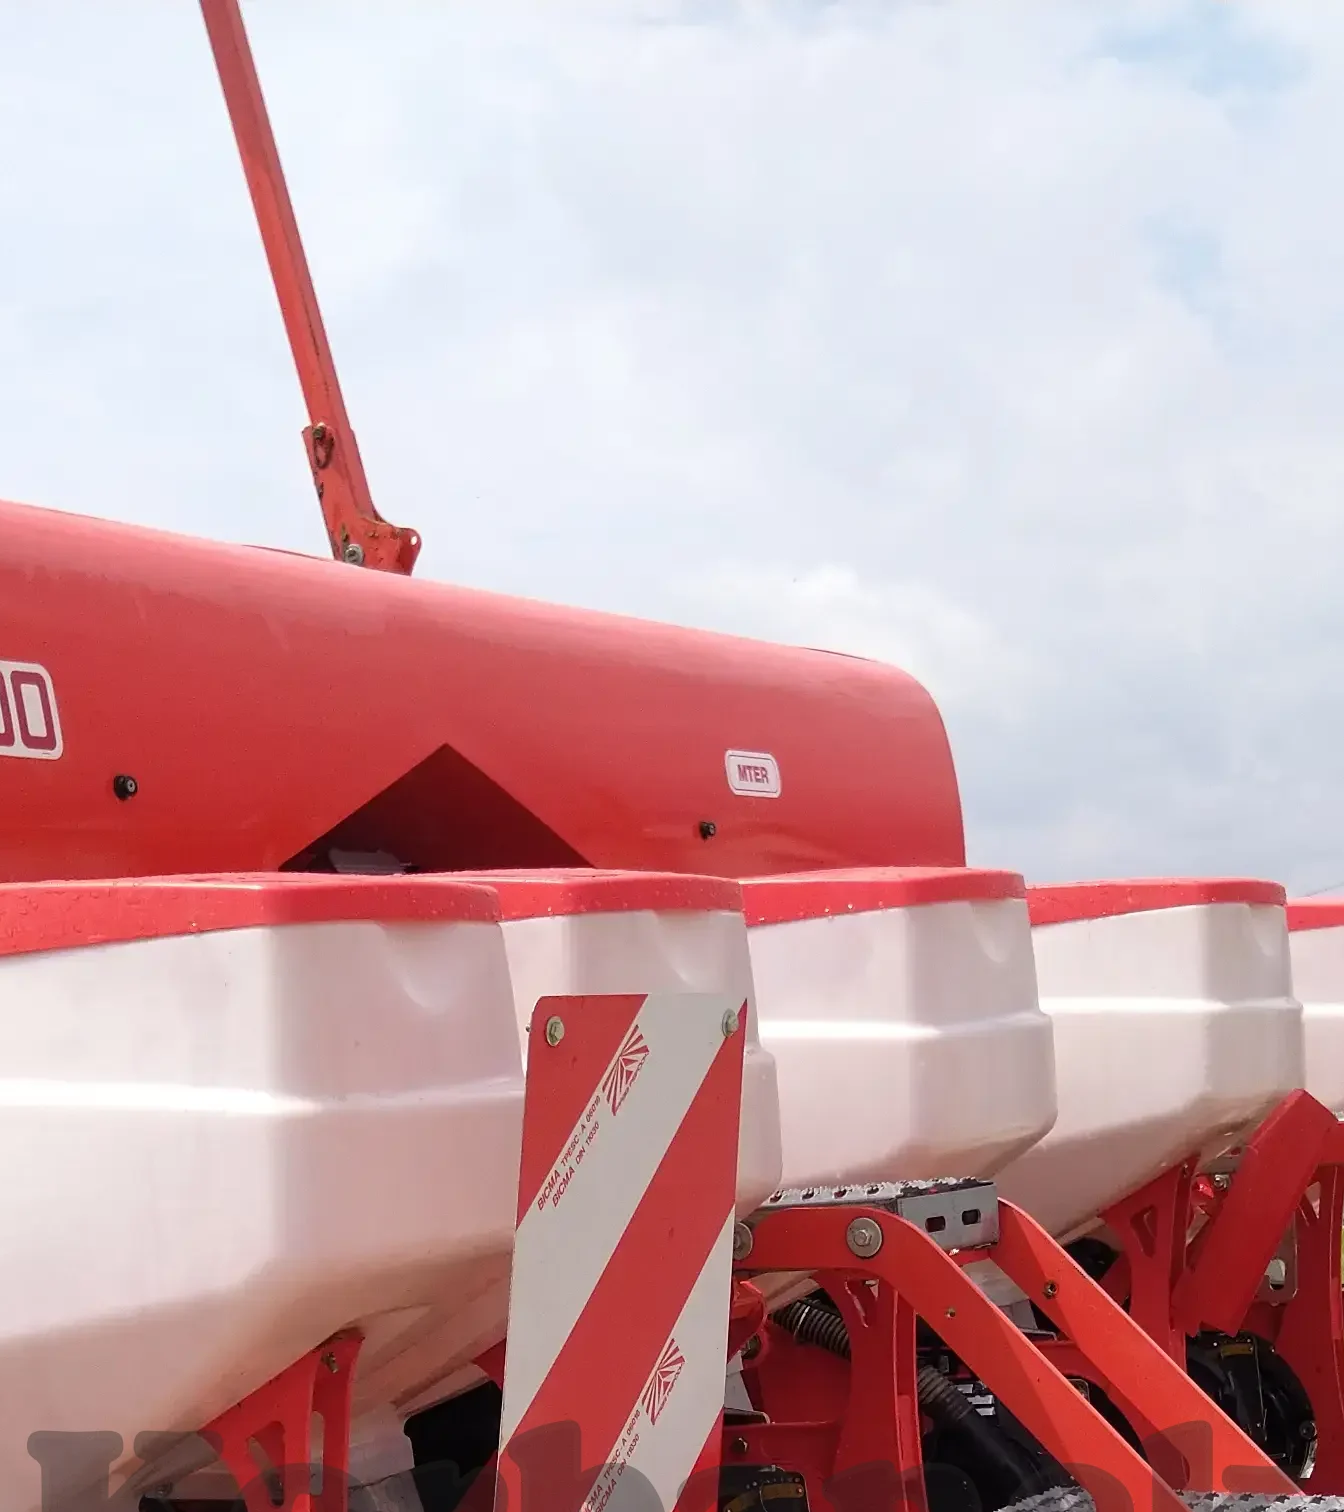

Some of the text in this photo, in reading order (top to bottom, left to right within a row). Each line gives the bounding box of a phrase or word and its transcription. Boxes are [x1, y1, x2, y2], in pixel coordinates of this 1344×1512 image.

[737, 764, 769, 784] MTER
[537, 1169, 561, 1210] BICMA
[552, 1166, 575, 1207] BICMA
